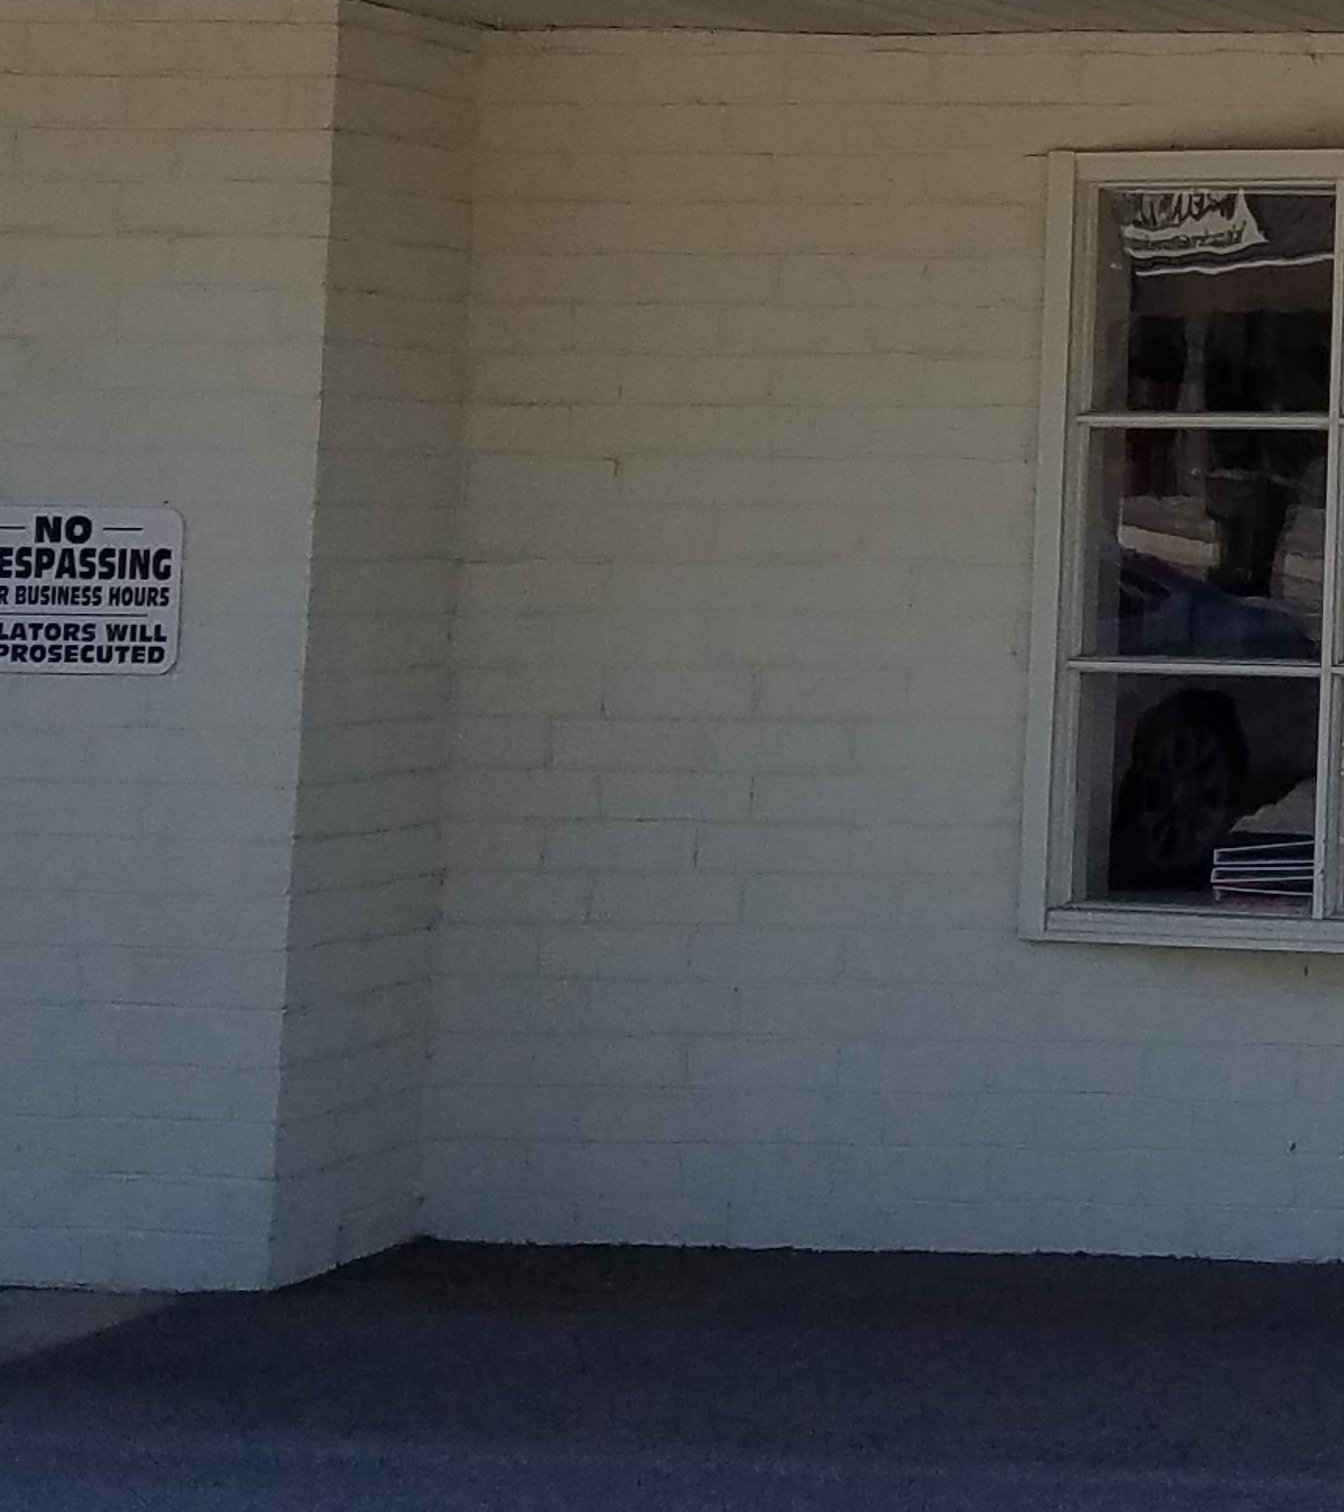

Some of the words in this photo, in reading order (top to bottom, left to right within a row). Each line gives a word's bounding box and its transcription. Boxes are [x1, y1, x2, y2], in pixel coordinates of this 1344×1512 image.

[34, 515, 93, 544] NO
[15, 585, 103, 607] BUSINESS
[108, 587, 170, 607] HOURS
[105, 623, 168, 643] WILL
[0, 644, 166, 665] PROSECUTED
